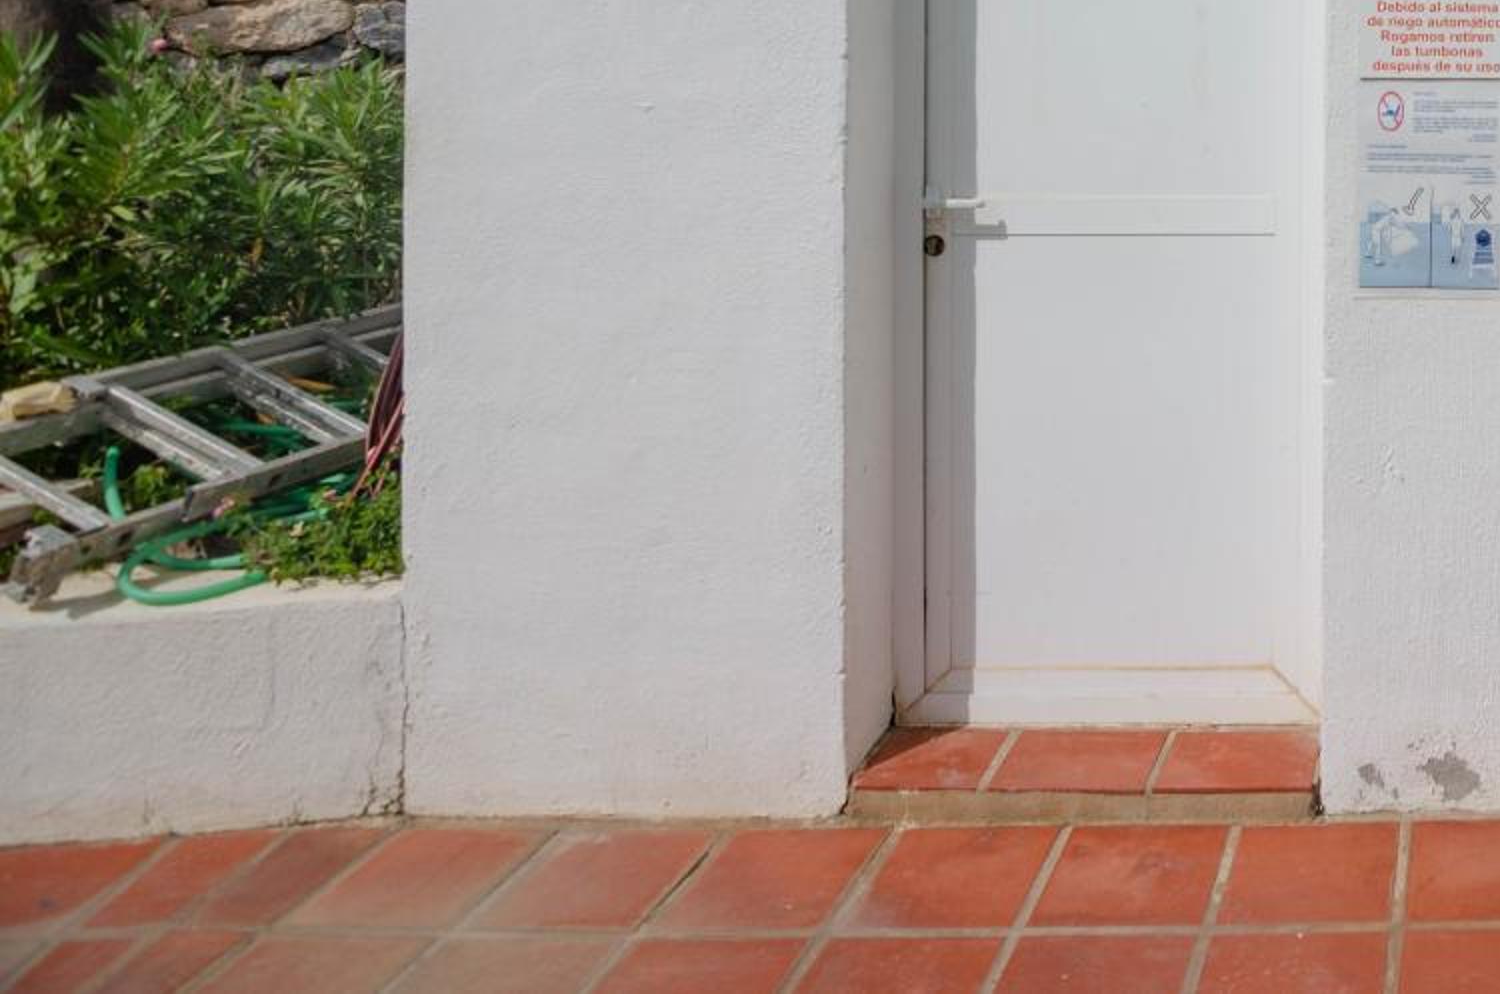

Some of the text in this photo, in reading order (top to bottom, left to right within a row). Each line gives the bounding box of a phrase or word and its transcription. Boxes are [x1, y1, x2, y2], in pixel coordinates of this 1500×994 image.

[1377, 1, 1498, 12] Debido al sistema
[1368, 17, 1384, 27] de
[1389, 17, 1423, 30] riego
[1381, 31, 1495, 43] Rogamos retiren
[1392, 46, 1483, 57] las tumbonas
[1373, 61, 1500, 73] después de su uso
